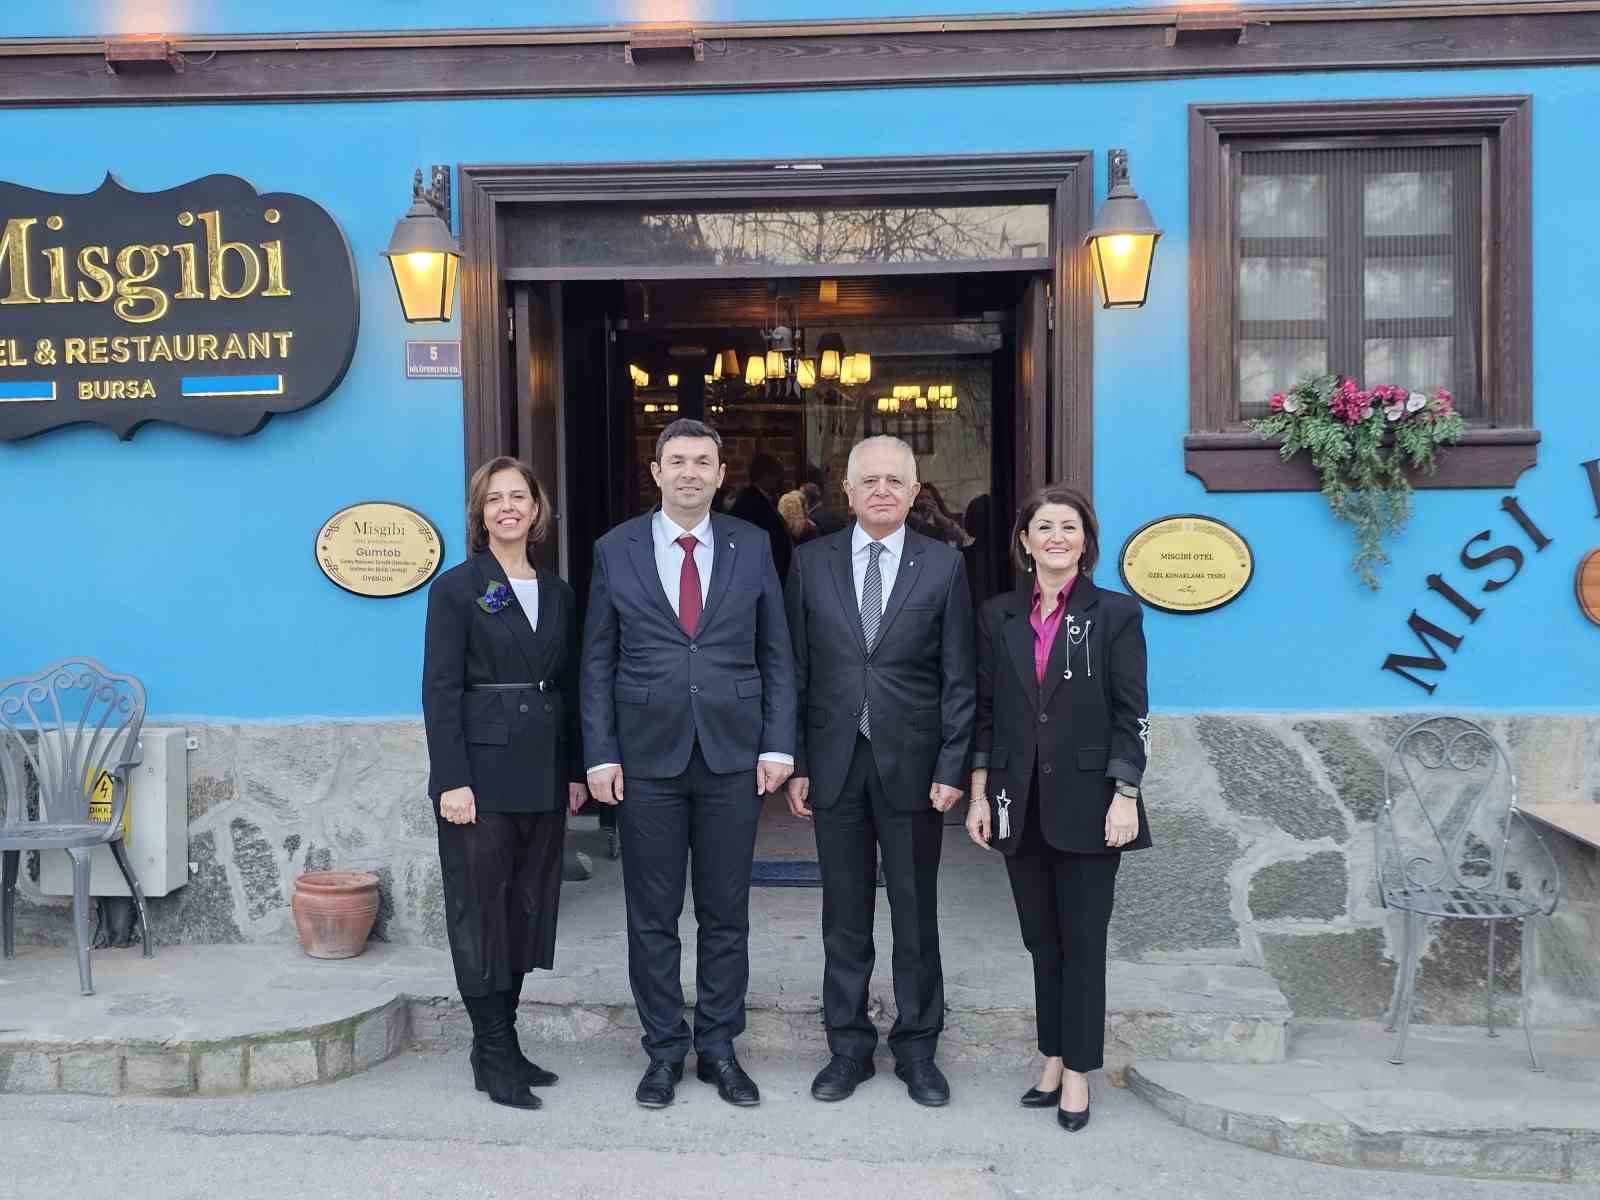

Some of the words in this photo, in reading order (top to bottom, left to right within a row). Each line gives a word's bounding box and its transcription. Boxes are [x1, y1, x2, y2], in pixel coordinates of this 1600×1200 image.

[34, 339, 57, 365] &
[65, 331, 294, 365] RESTAURANT
[430, 346, 438, 361] 5
[78, 379, 157, 401] BURSA
[353, 520, 406, 537] Misgibi
[1193, 553, 1214, 561] OTEL
